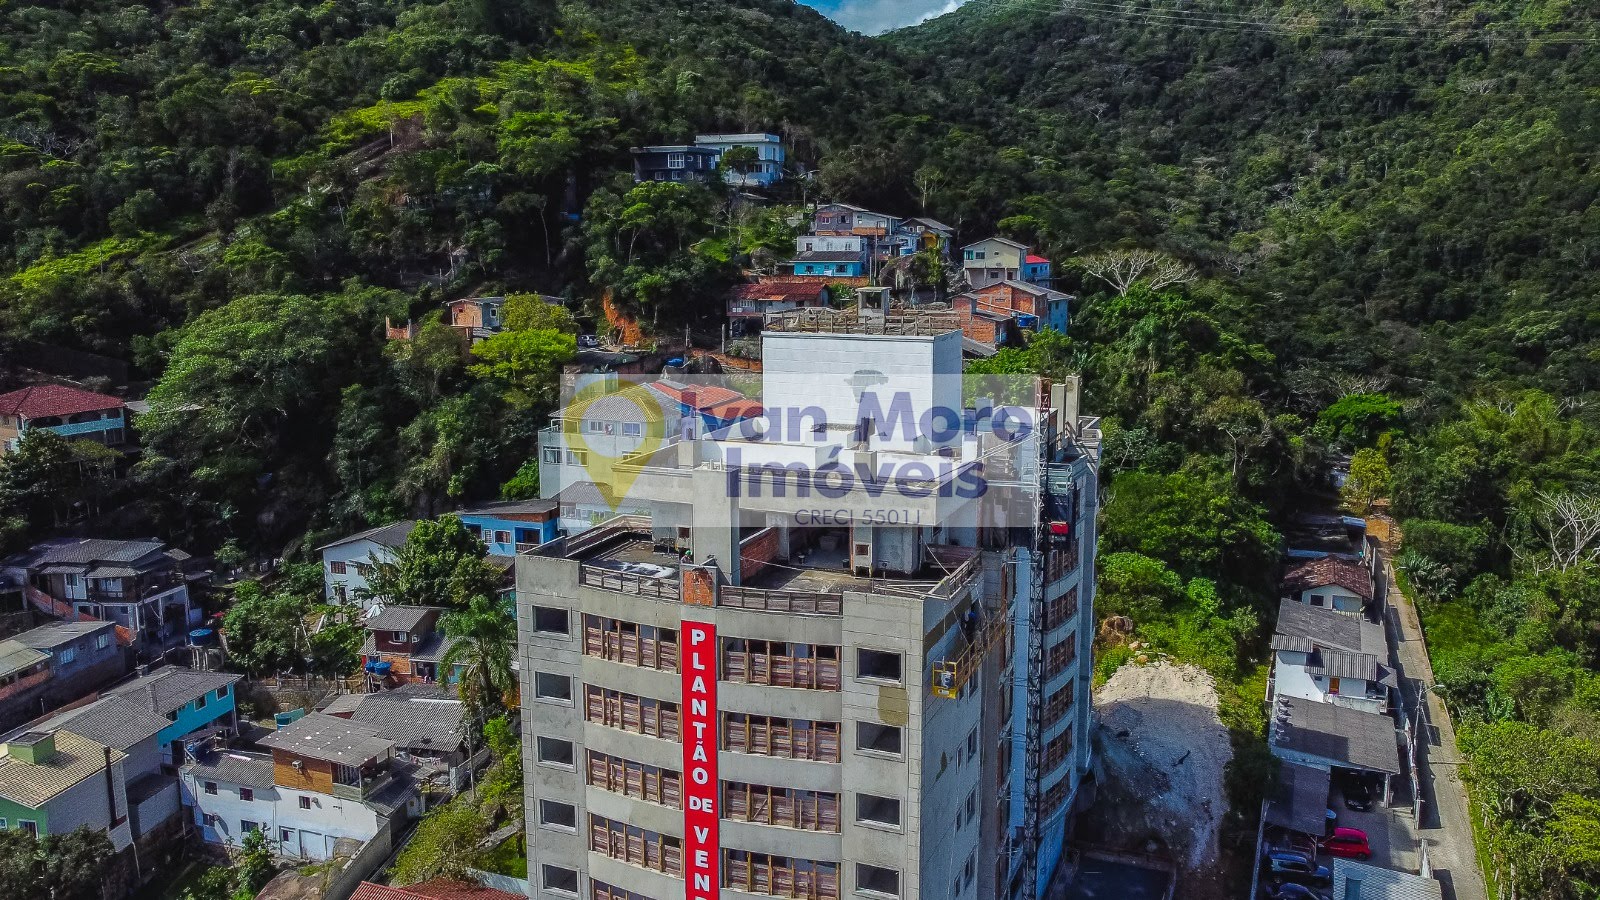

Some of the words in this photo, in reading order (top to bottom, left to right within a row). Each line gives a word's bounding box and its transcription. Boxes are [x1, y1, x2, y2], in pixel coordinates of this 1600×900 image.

[691, 628, 709, 785] PLANTÃO
[689, 796, 714, 814] DE
[693, 826, 711, 900] VEN
